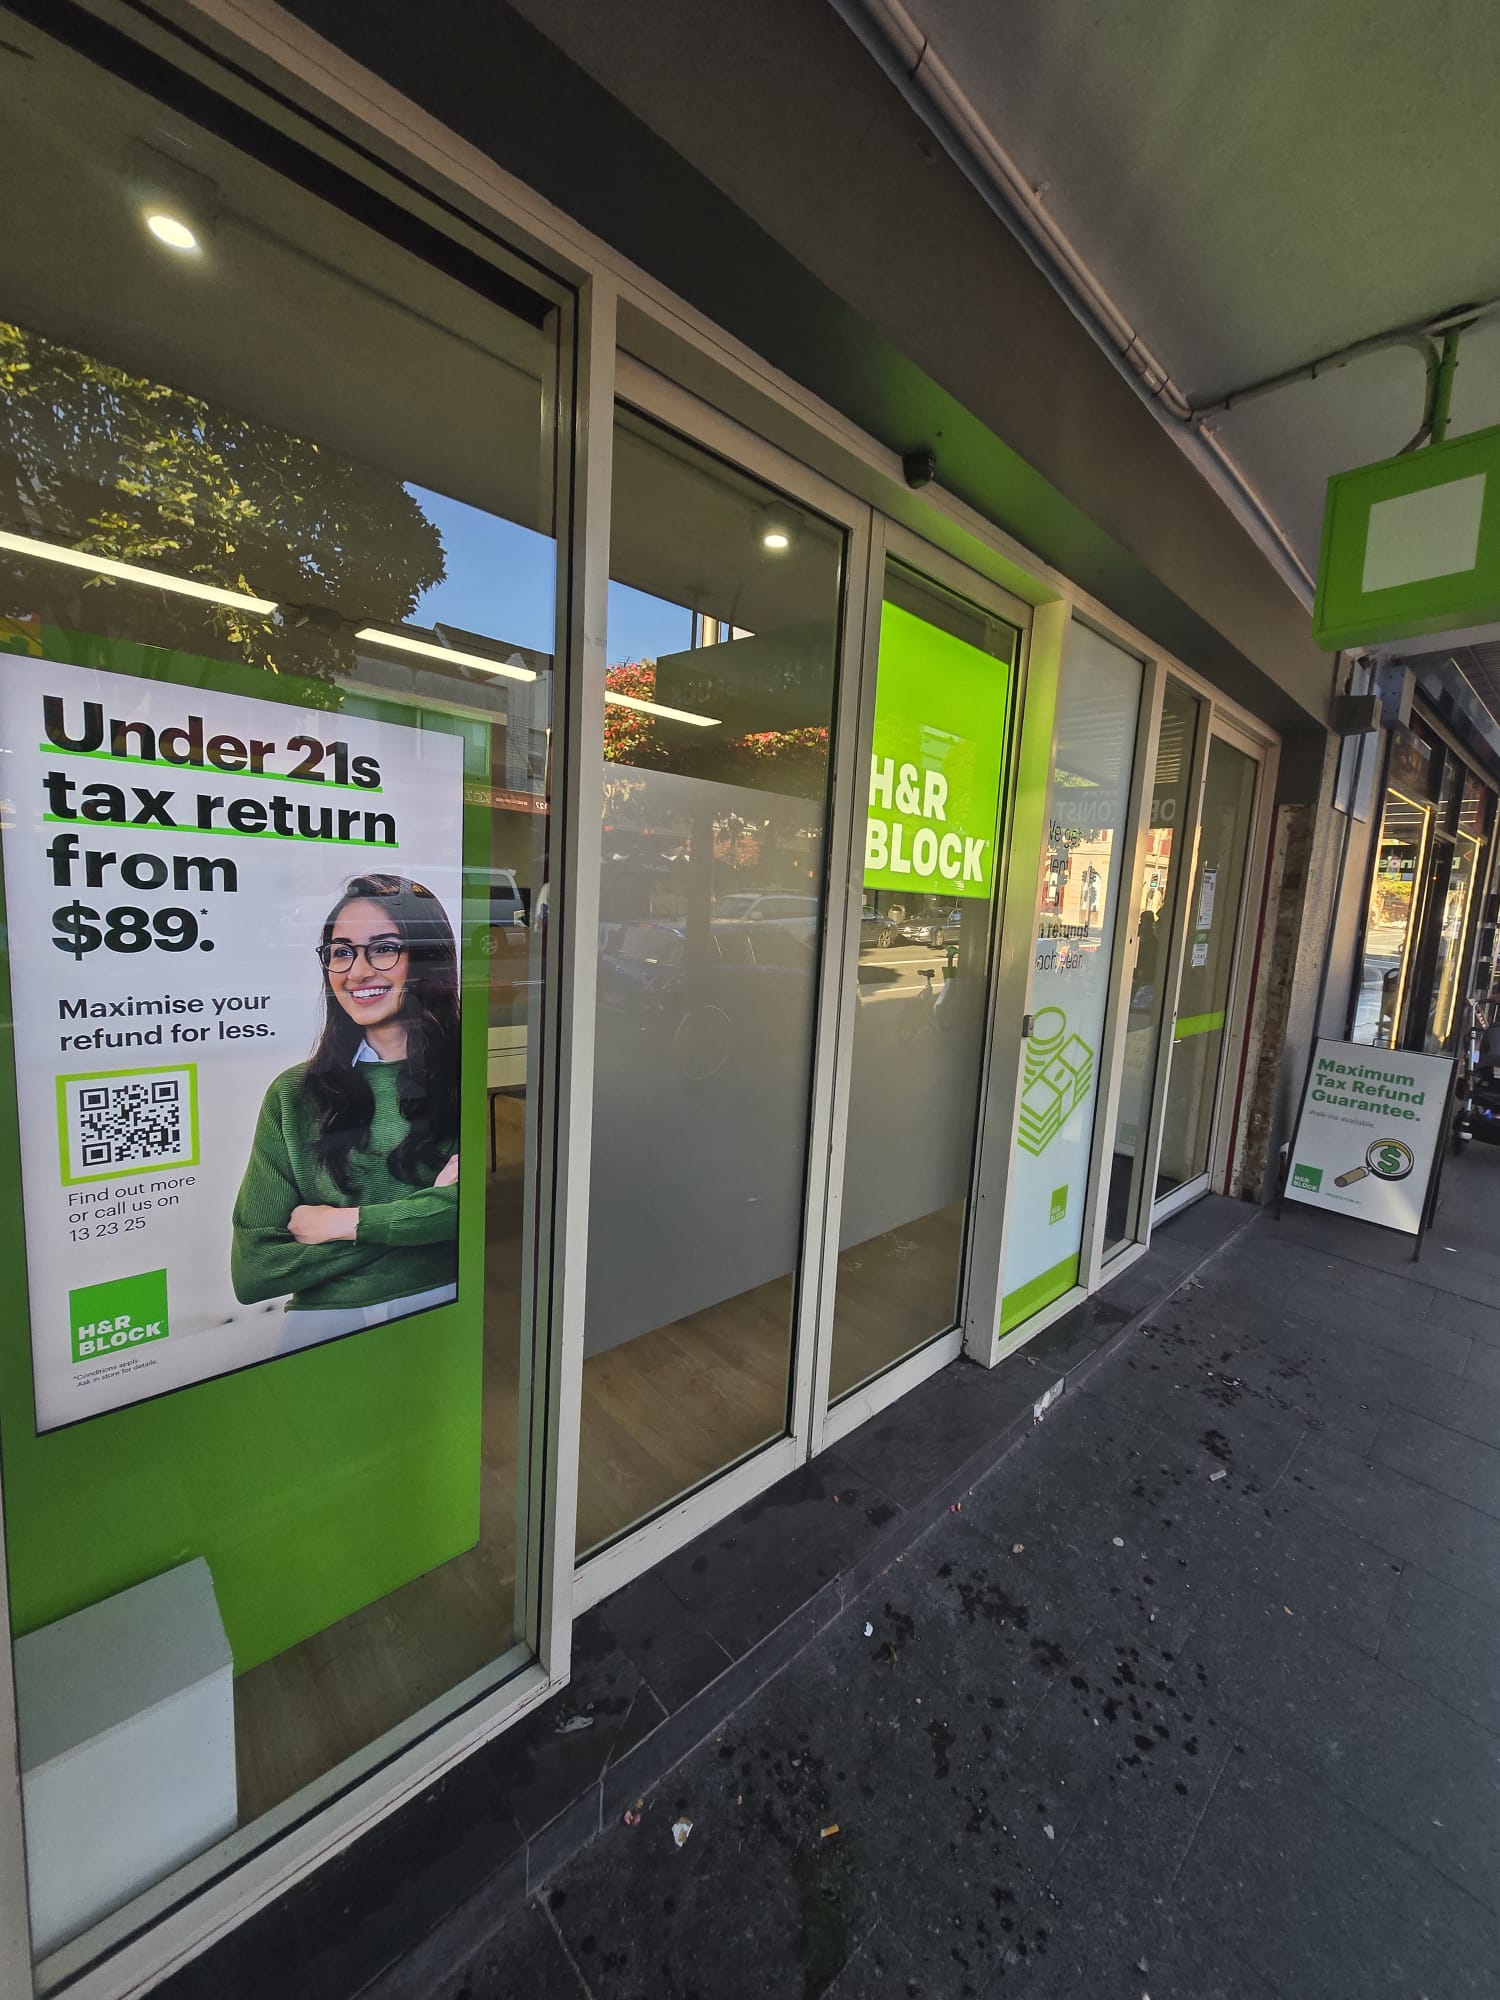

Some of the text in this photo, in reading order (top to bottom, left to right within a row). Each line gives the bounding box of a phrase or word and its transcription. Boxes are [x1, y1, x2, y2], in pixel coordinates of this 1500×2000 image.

[42, 695, 382, 789] Under 21s
[869, 753, 949, 821] H&R
[43, 771, 397, 845] tax return
[46, 833, 239, 893] from
[864, 817, 987, 883] BLOCK
[58, 993, 271, 1021] Maximise your
[60, 1019, 277, 1052] refund for less.
[1317, 1057, 1416, 1088] Maximum
[1311, 1088, 1422, 1123] Guarantee.
[1315, 1073, 1426, 1107] Tax Refund
[68, 1174, 197, 1207] Find out more
[68, 1194, 180, 1225] or call us on
[69, 1217, 147, 1243] 13 23 25
[78, 1315, 131, 1341] H&R
[78, 1321, 163, 1357] BLOCK
[101, 1370, 121, 1380] store
